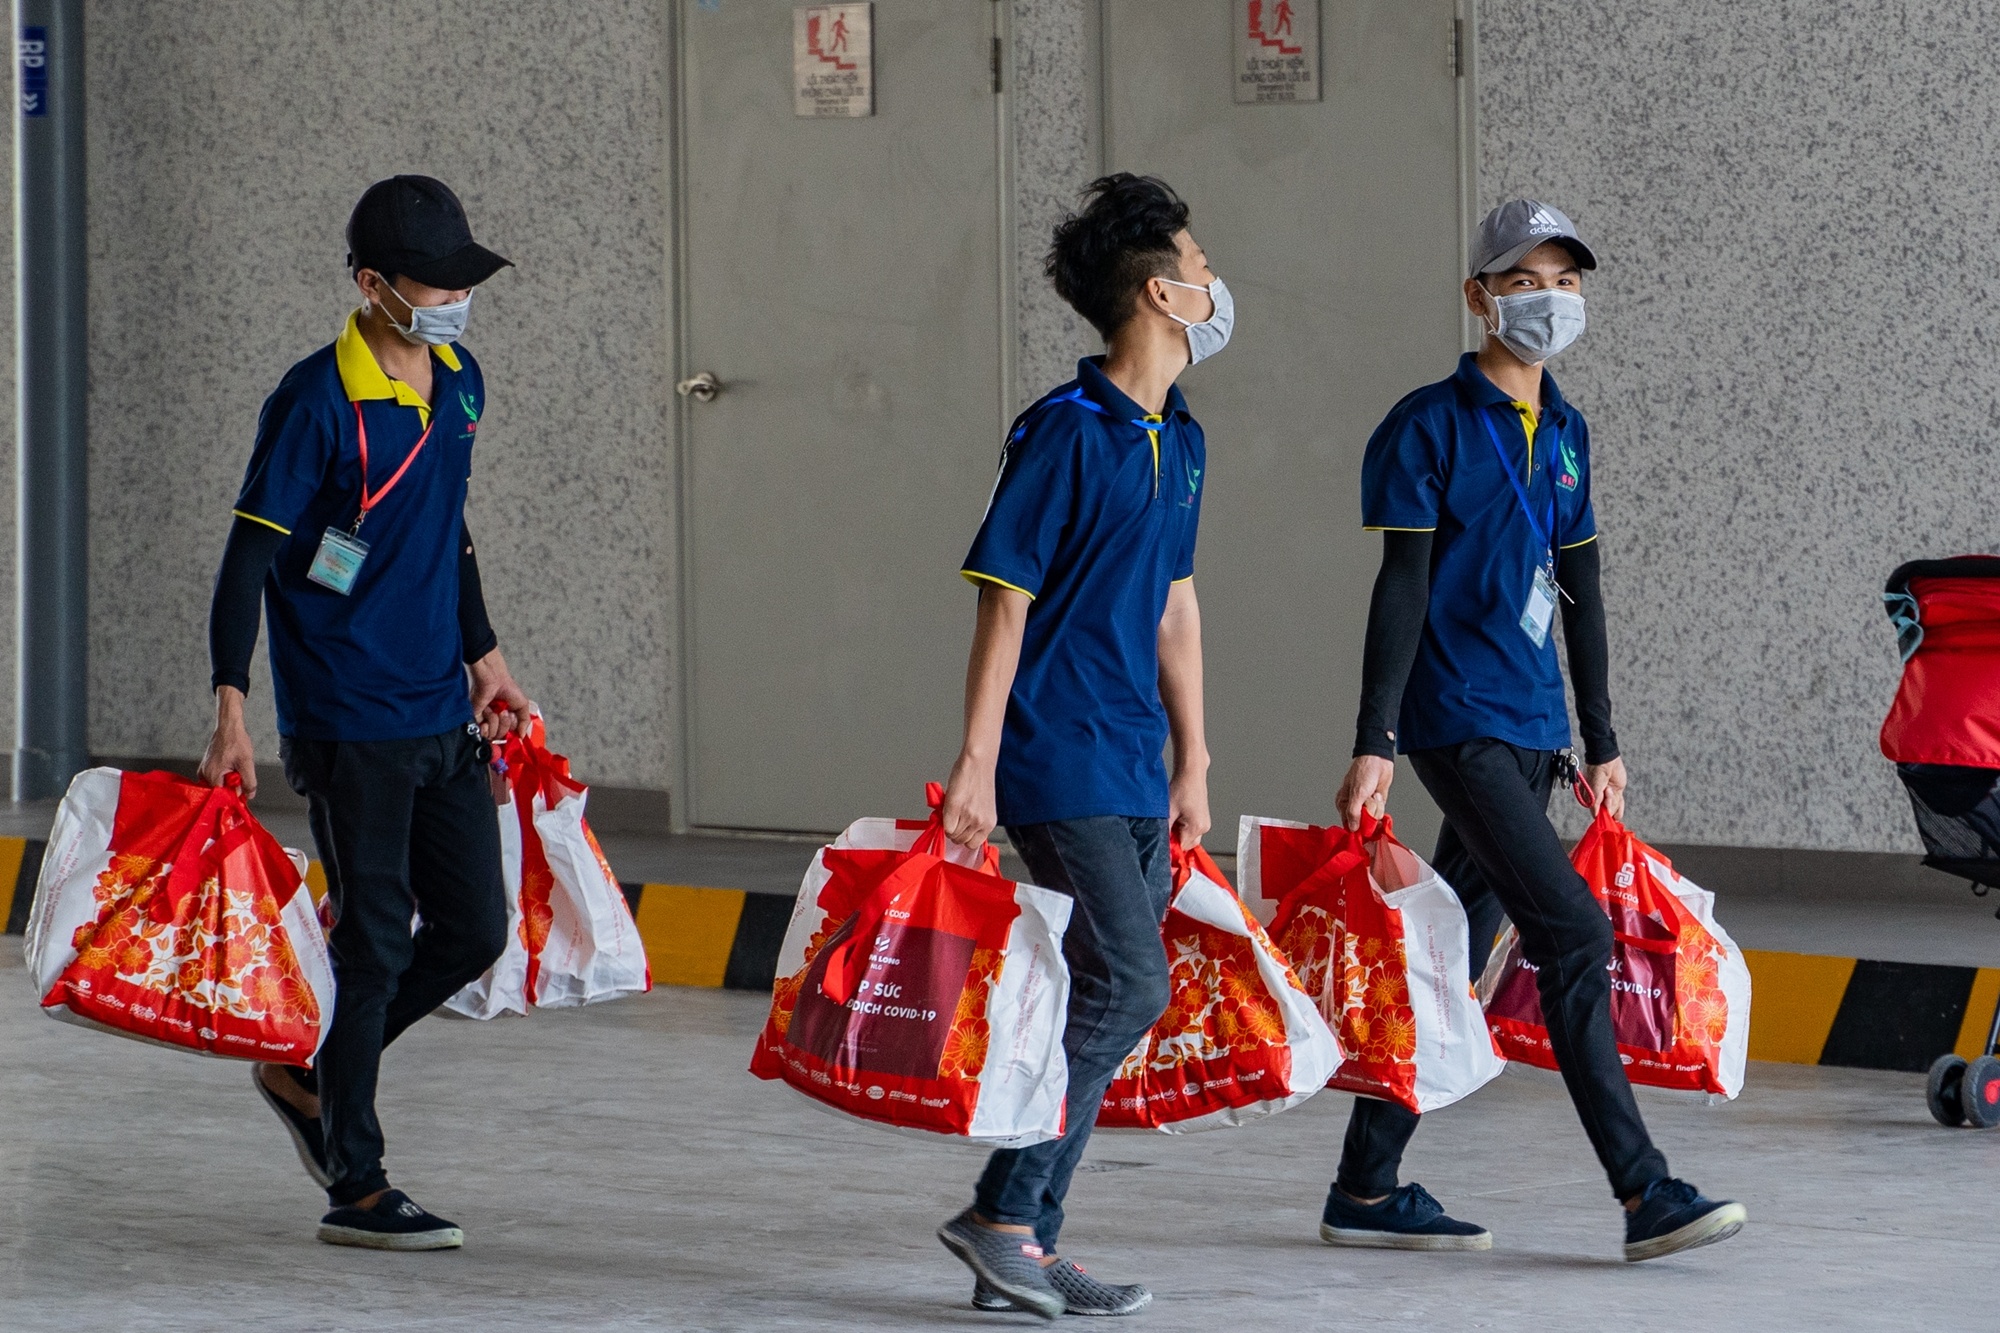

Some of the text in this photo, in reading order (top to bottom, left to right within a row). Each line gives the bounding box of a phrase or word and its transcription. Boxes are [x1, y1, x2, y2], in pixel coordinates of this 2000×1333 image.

[1529, 223, 1563, 236] adidas
[878, 955, 901, 966] LONG
[873, 981, 902, 999] SỨC
[851, 1000, 882, 1015] DỊCH
[883, 1005, 937, 1022] COVID-19
